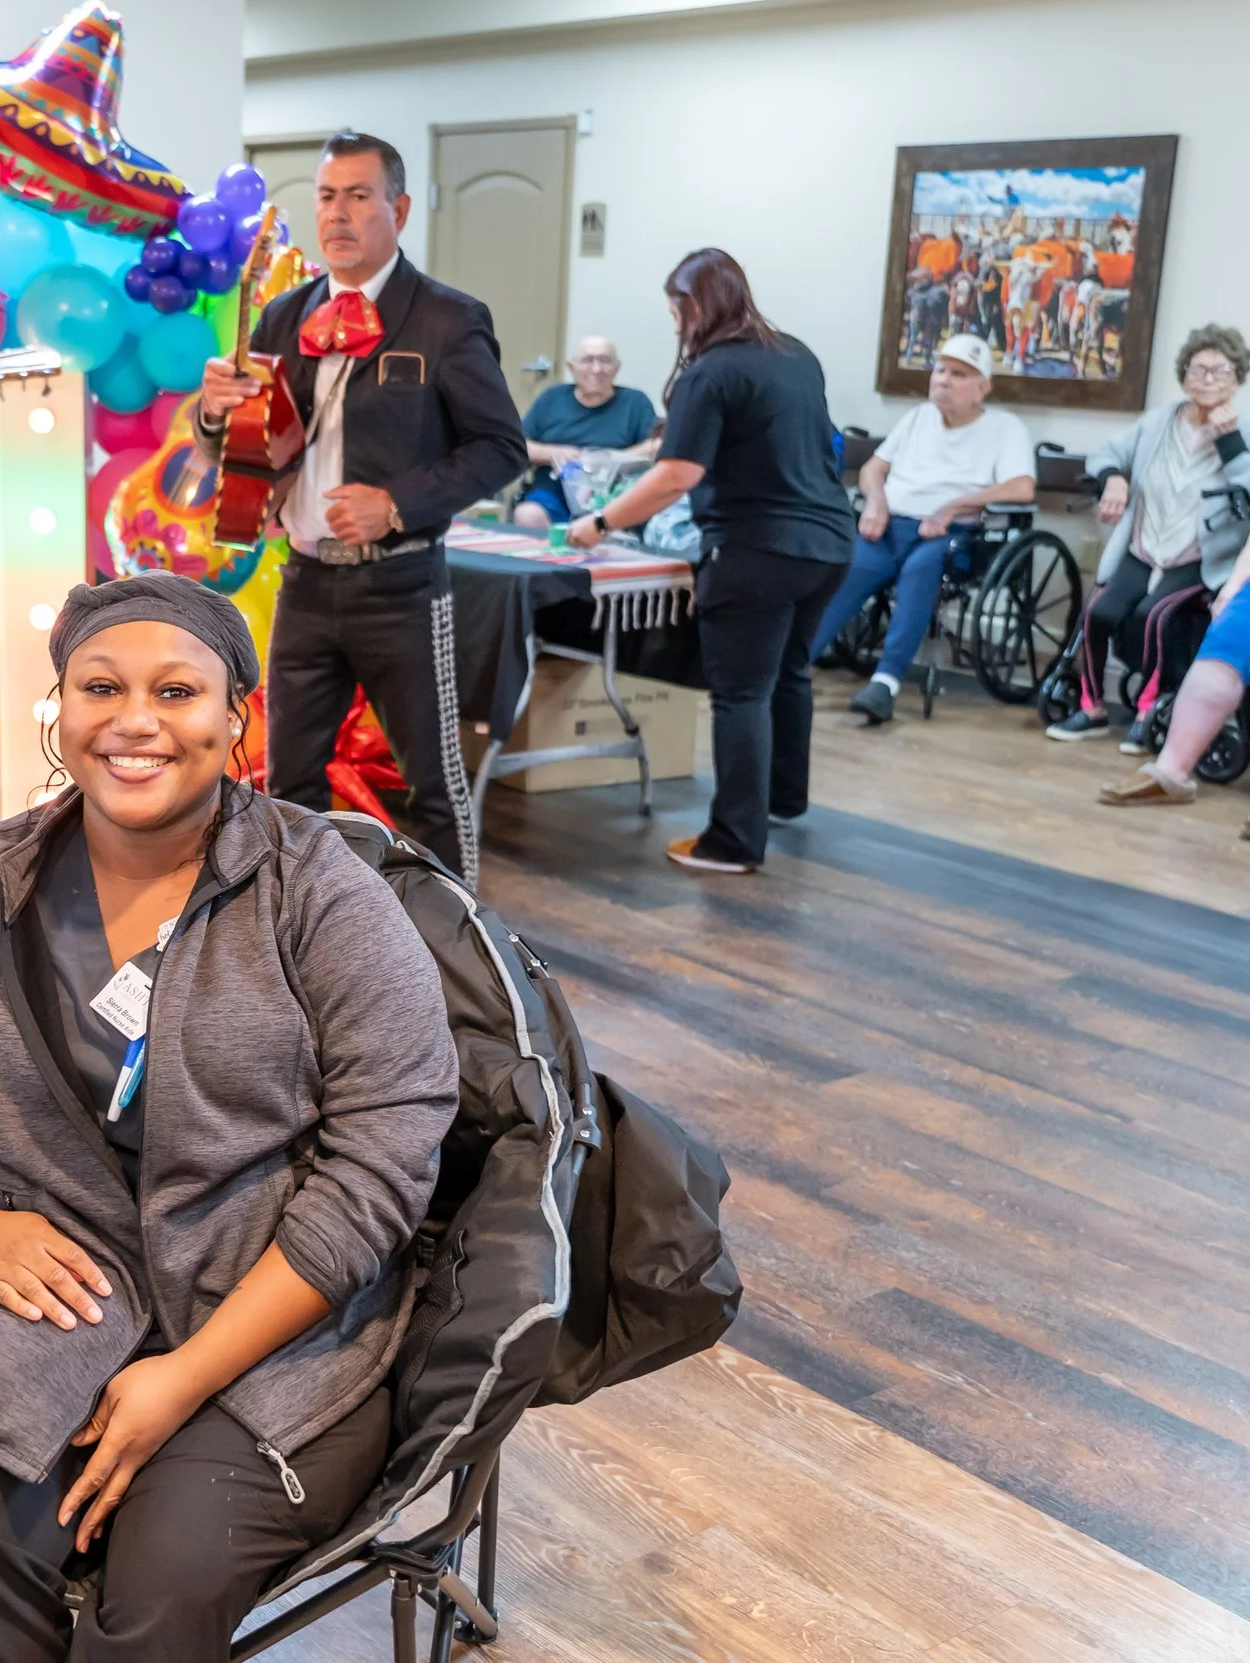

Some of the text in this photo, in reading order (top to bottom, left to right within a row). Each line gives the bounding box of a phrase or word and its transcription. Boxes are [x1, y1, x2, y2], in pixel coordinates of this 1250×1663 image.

[96, 1002, 114, 1019] Certified
[112, 1015, 125, 1028] Nurse
[106, 997, 123, 1013] Sierra
[121, 1009, 139, 1026] Brown
